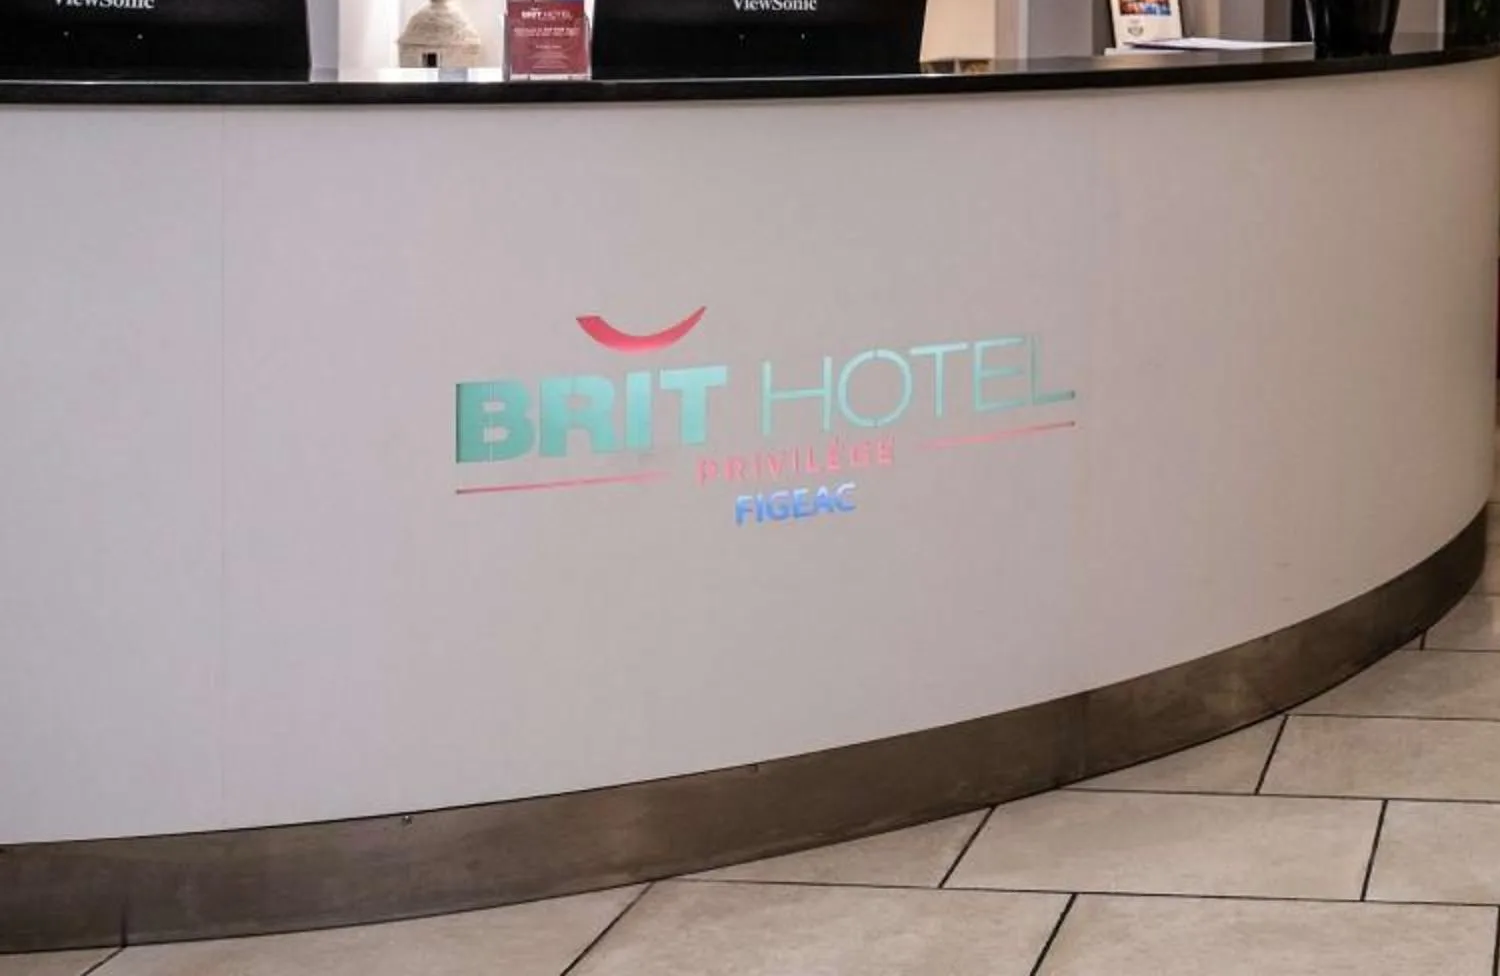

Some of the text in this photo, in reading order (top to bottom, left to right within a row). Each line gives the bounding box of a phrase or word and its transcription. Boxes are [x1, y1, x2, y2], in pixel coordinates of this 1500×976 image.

[455, 334, 1076, 464] BRIT HOTEL
[734, 481, 857, 527] FIGEAC
